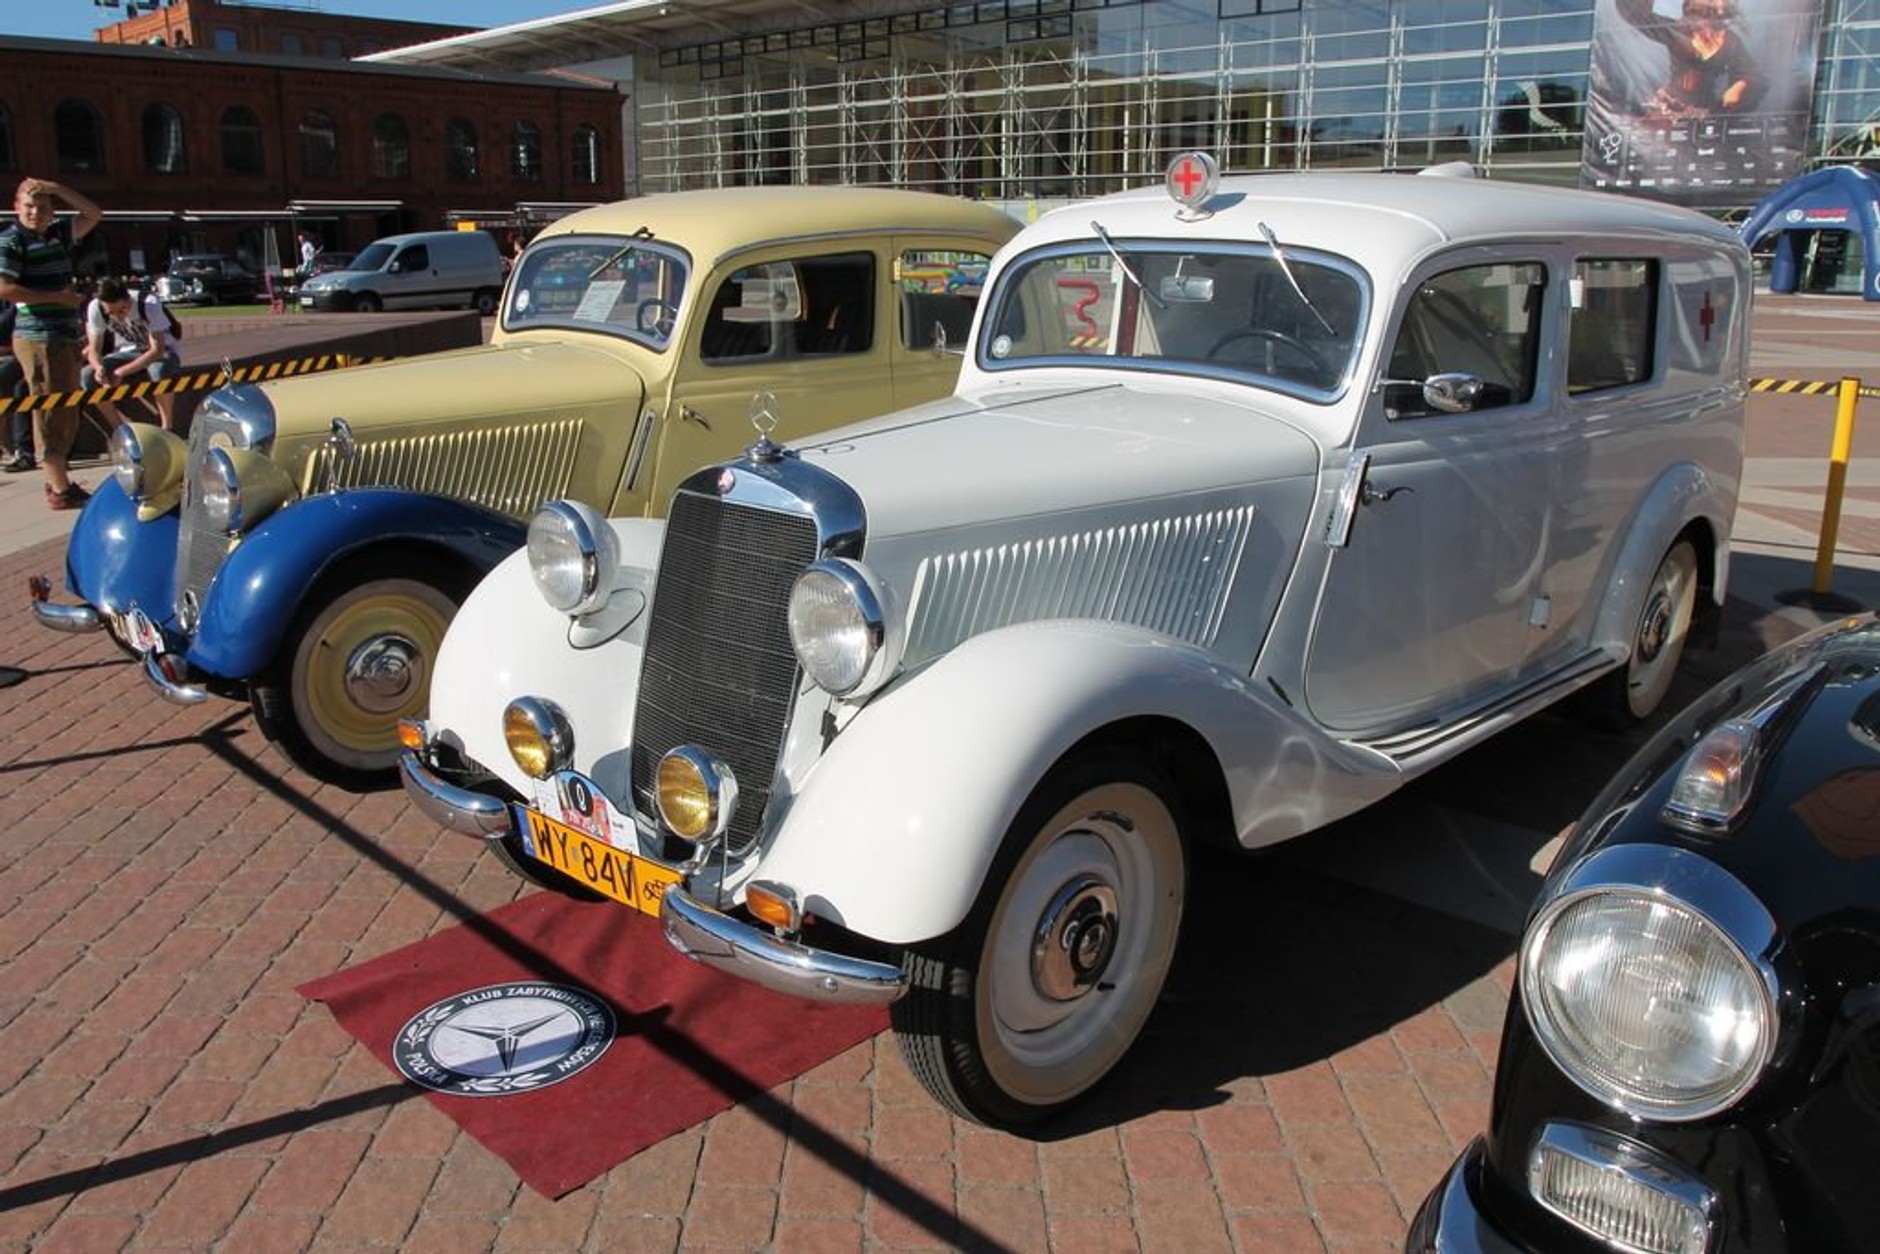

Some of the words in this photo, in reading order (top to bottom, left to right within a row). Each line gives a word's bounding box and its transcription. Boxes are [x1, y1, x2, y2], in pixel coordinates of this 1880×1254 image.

[532, 817, 569, 869] WY
[580, 841, 634, 900] 84V
[462, 988, 503, 1005] KLUB
[404, 1051, 449, 1085] POLSKA
